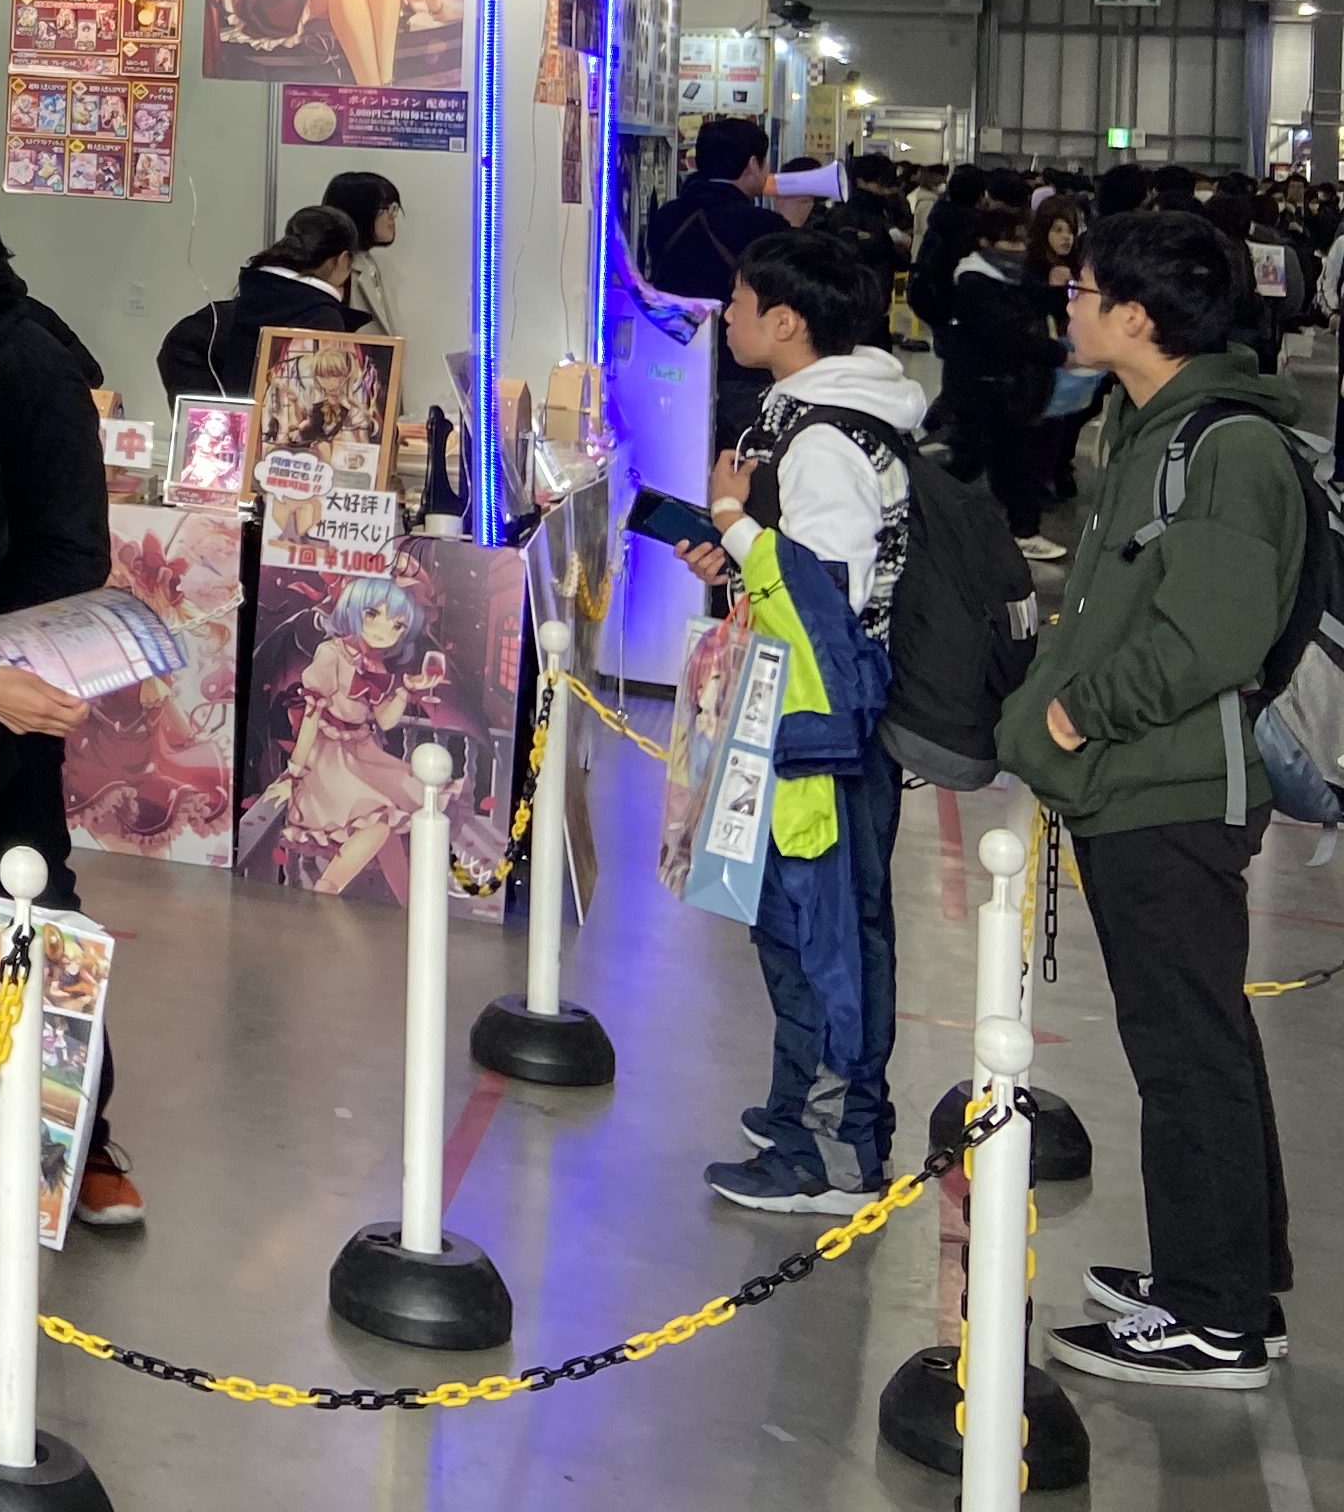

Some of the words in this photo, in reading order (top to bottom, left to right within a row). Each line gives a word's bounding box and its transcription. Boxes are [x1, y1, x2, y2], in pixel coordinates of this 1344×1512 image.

[348, 95, 421, 108] ポイントコイン
[425, 98, 466, 110] 配布中!
[326, 492, 391, 515] 大好評!
[316, 519, 390, 543] ガラガラくじ!
[288, 545, 317, 566] 1回
[324, 546, 386, 574] ¥1,000
